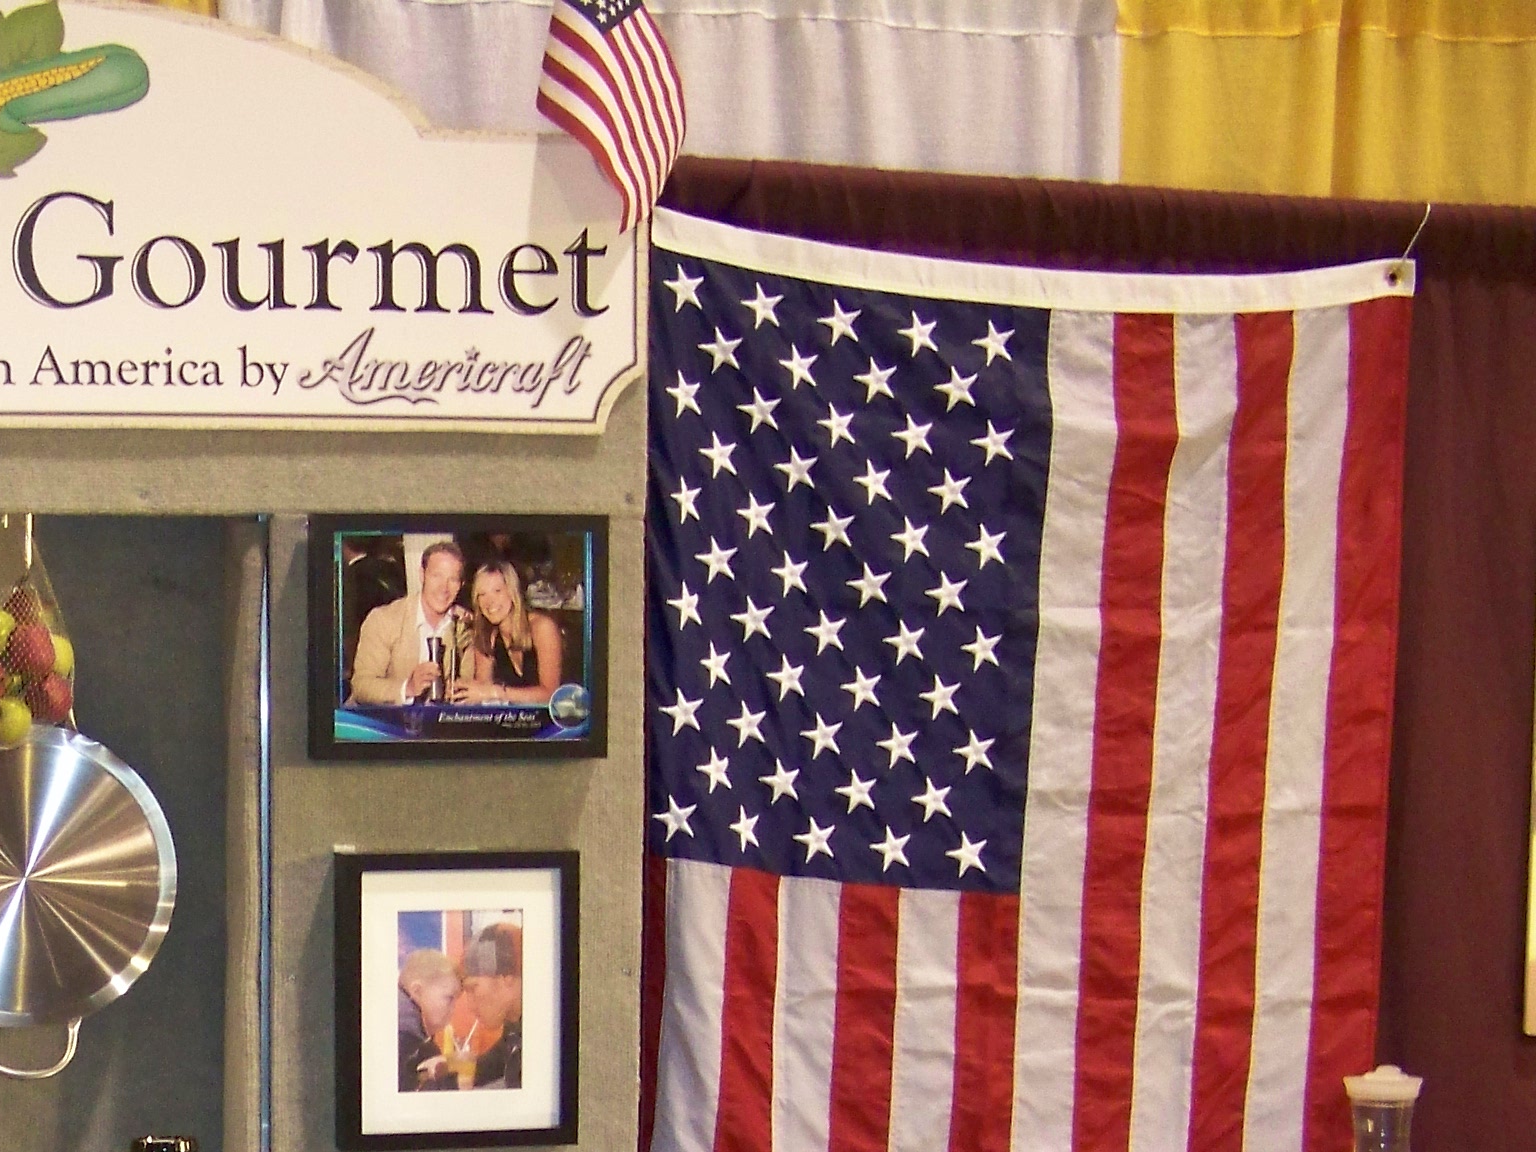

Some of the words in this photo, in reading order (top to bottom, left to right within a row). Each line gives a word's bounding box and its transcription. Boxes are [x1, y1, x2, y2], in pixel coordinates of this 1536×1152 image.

[12, 190, 611, 318] Gourmet
[30, 344, 224, 388] America
[239, 344, 290, 393] by
[298, 326, 594, 408] Americraft
